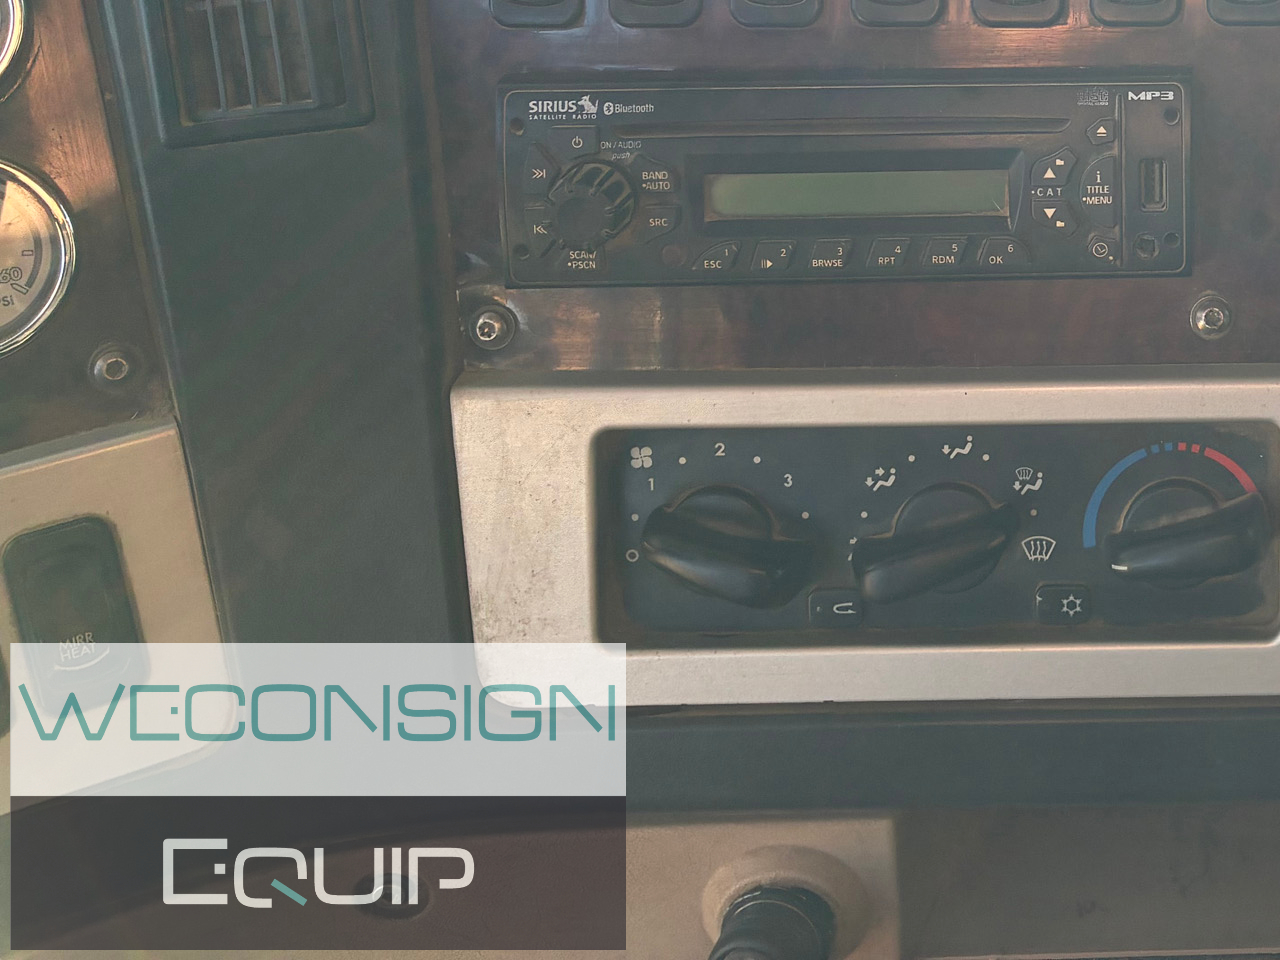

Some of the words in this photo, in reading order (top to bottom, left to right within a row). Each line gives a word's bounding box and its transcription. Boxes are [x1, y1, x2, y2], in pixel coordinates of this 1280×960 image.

[1128, 91, 1174, 100] MP3
[528, 100, 577, 114] SIRIUS
[614, 103, 654, 113] Bluetooth
[642, 171, 668, 180] BAND
[646, 181, 670, 190] AUTO
[1086, 185, 1110, 194] TITLE
[1086, 196, 1112, 204] MENU
[649, 218, 668, 227] SRC
[780, 248, 787, 256] 2
[837, 247, 843, 255] 3
[952, 244, 958, 252] 5
[1008, 244, 1014, 252] 6
[812, 259, 843, 267] BRWSE
[932, 255, 955, 263] RDM
[989, 256, 1003, 264] OK
[704, 260, 722, 269] ESC
[714, 443, 726, 457] 2
[647, 478, 656, 491] 1
[783, 473, 793, 487] 3
[60, 632, 94, 651] MIRR
[60, 642, 96, 662] HEAT
